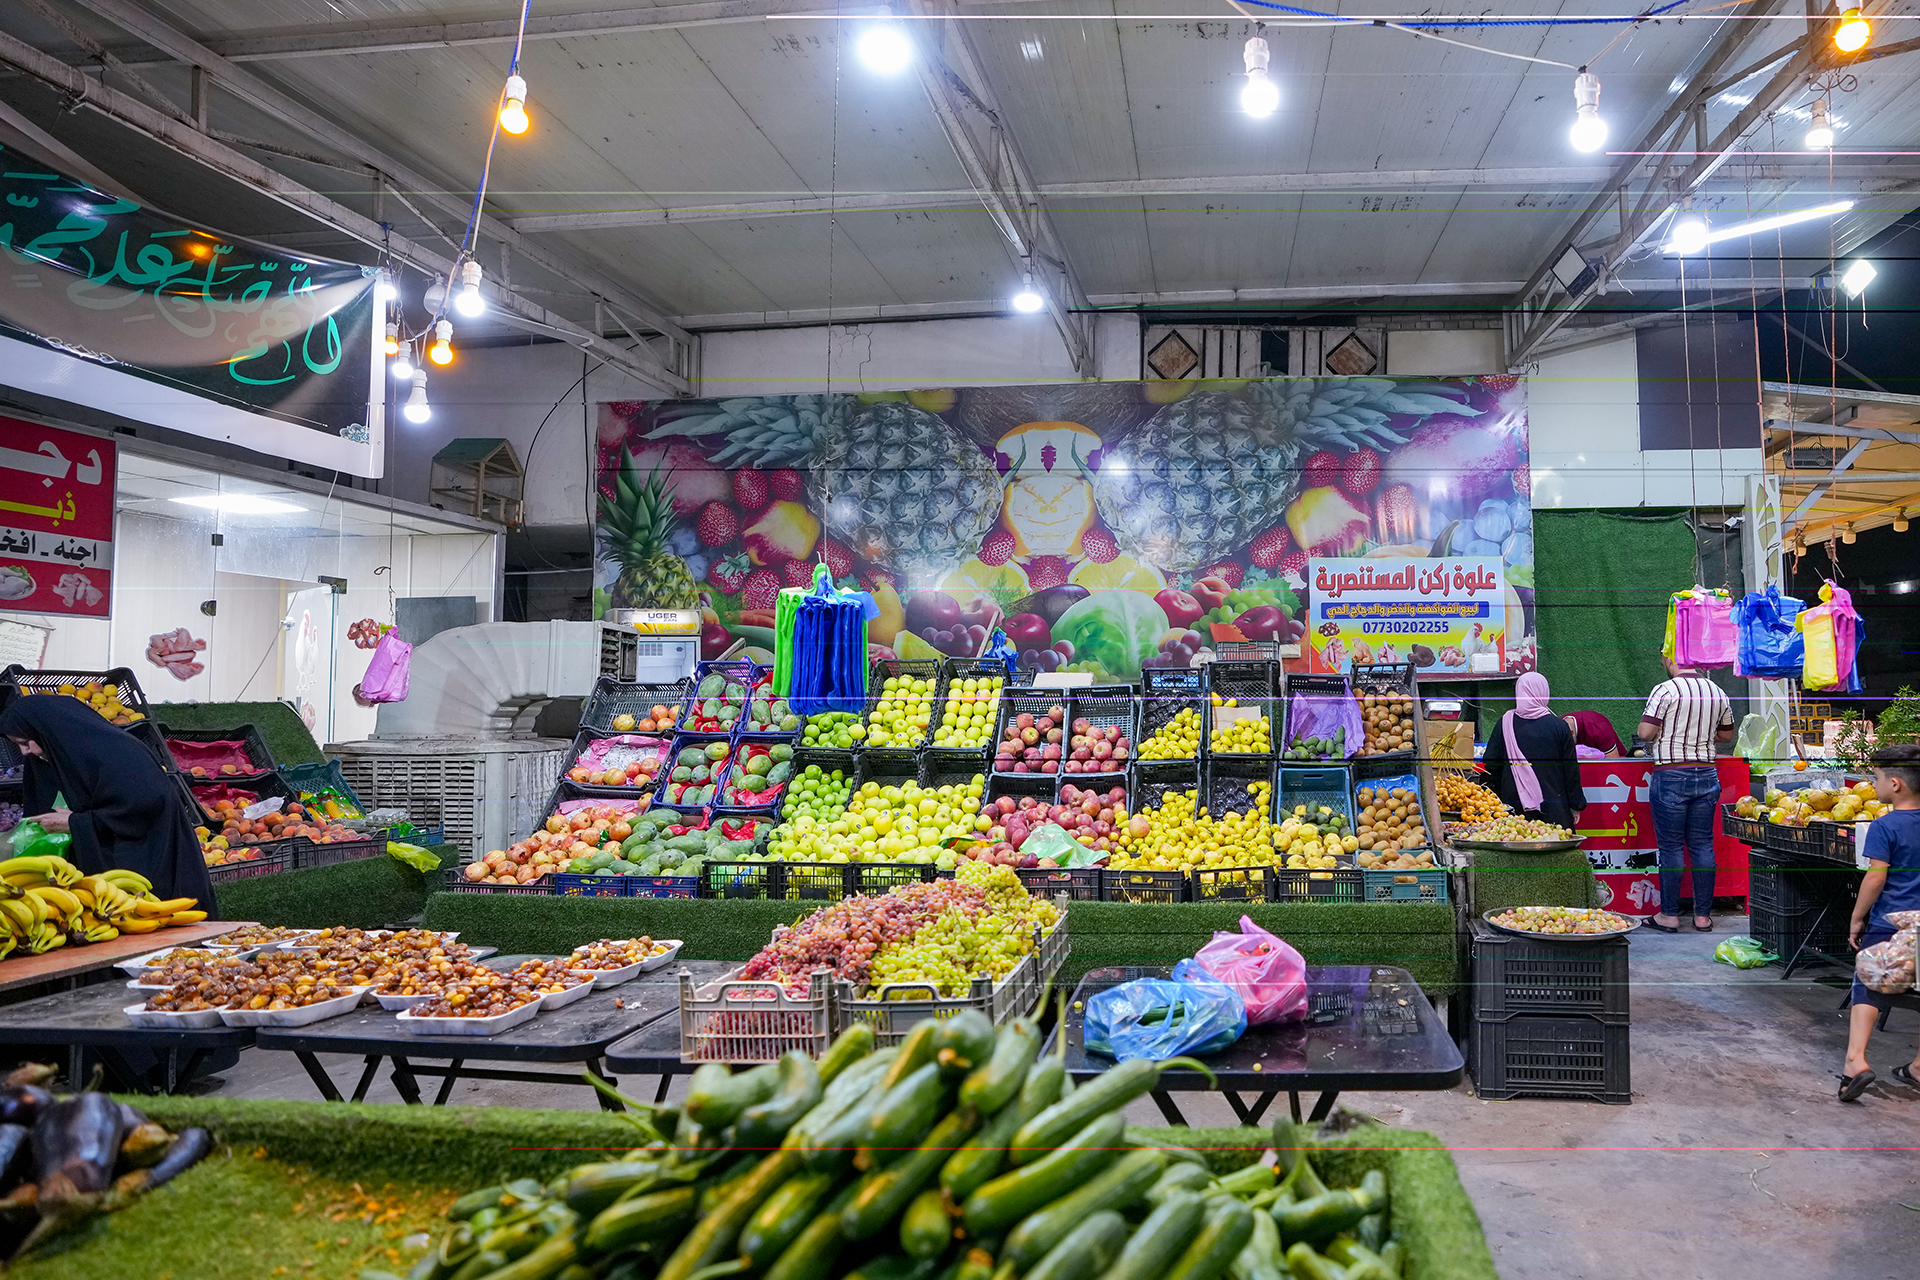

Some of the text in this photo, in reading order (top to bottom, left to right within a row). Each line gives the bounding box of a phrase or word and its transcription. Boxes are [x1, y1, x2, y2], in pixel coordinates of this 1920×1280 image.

[1316, 562, 1497, 598] علوة ركن المستنصرية
[1326, 603, 1349, 618] الحي
[1350, 603, 1385, 618] والدجاج
[1363, 621, 1449, 634] 07730202255
